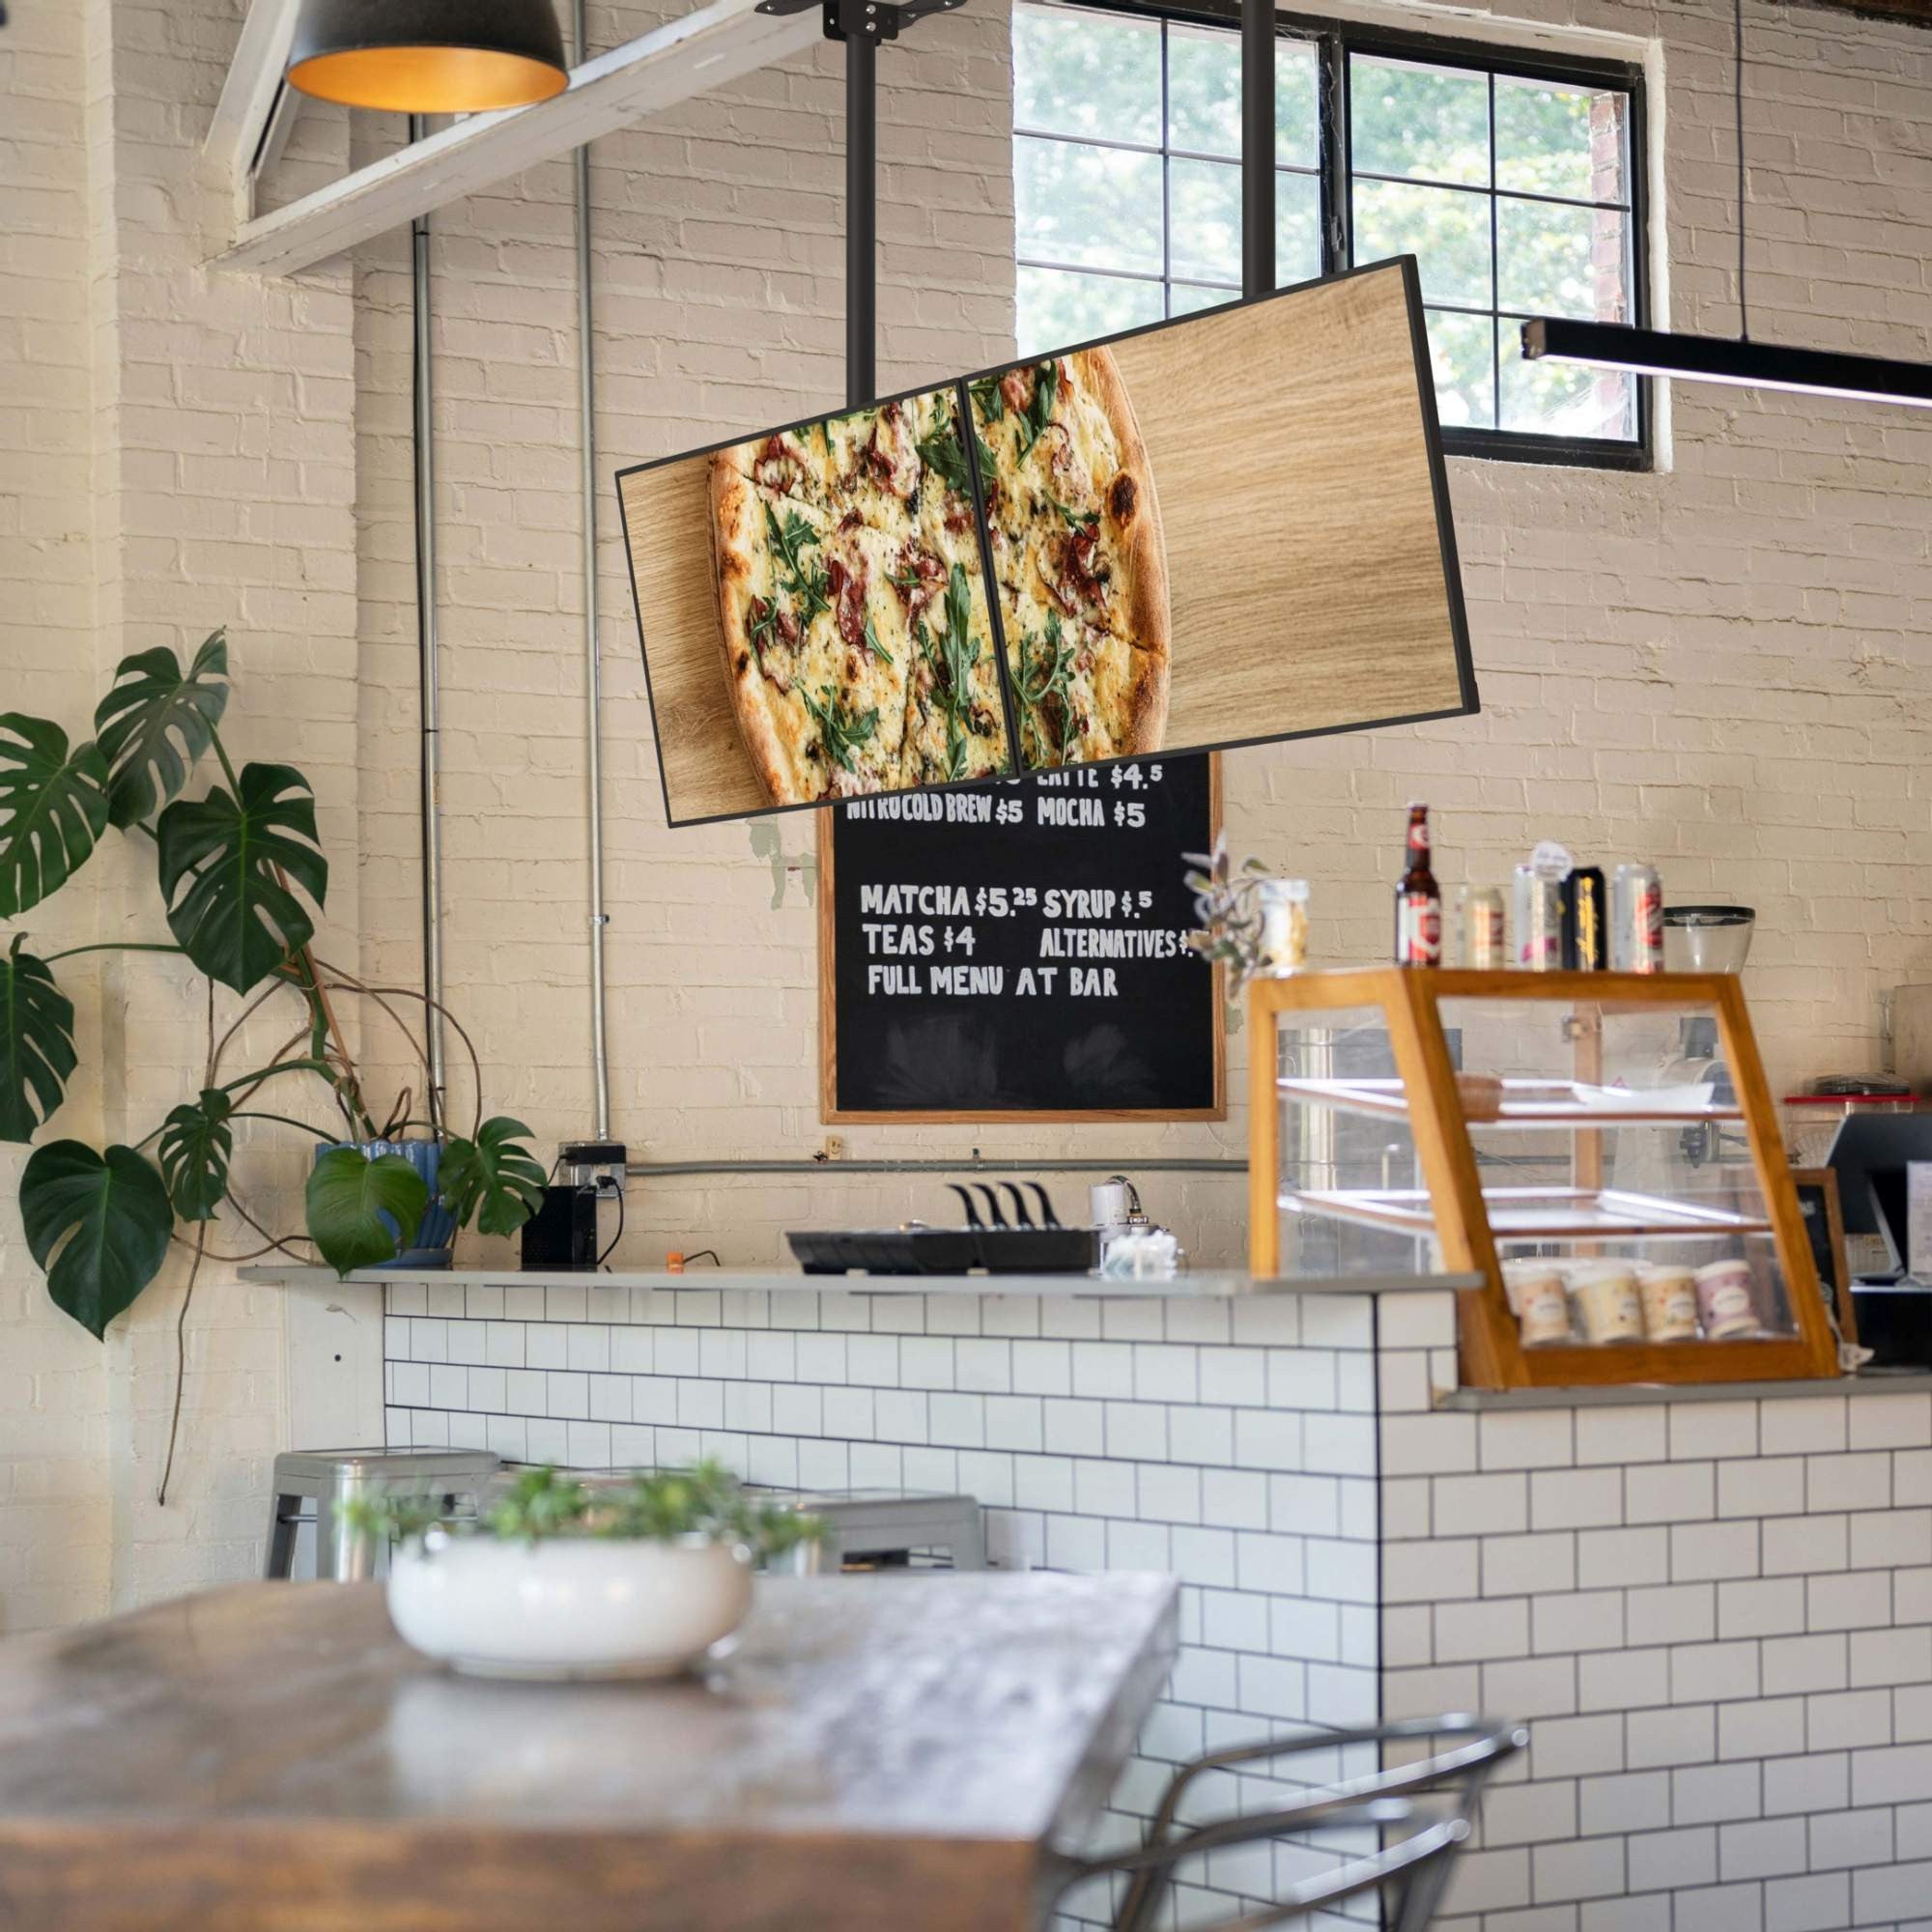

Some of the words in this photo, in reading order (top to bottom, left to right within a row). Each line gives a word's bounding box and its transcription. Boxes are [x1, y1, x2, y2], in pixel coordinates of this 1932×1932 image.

[945, 792, 992, 823] BREW
[995, 798, 1024, 825] $5
[1037, 796, 1106, 827] MOCHA
[1113, 800, 1146, 828] $5
[860, 884, 971, 916] MATCHA
[1042, 889, 1117, 919] SYRUP
[862, 923, 935, 956] TEAS
[943, 925, 977, 956] $4
[1038, 927, 1177, 958] ALTERNATIVES
[867, 964, 923, 996] FULL
[929, 965, 1004, 996] MENU
[1014, 966, 1059, 996] AT
[1069, 966, 1119, 997] BAR
